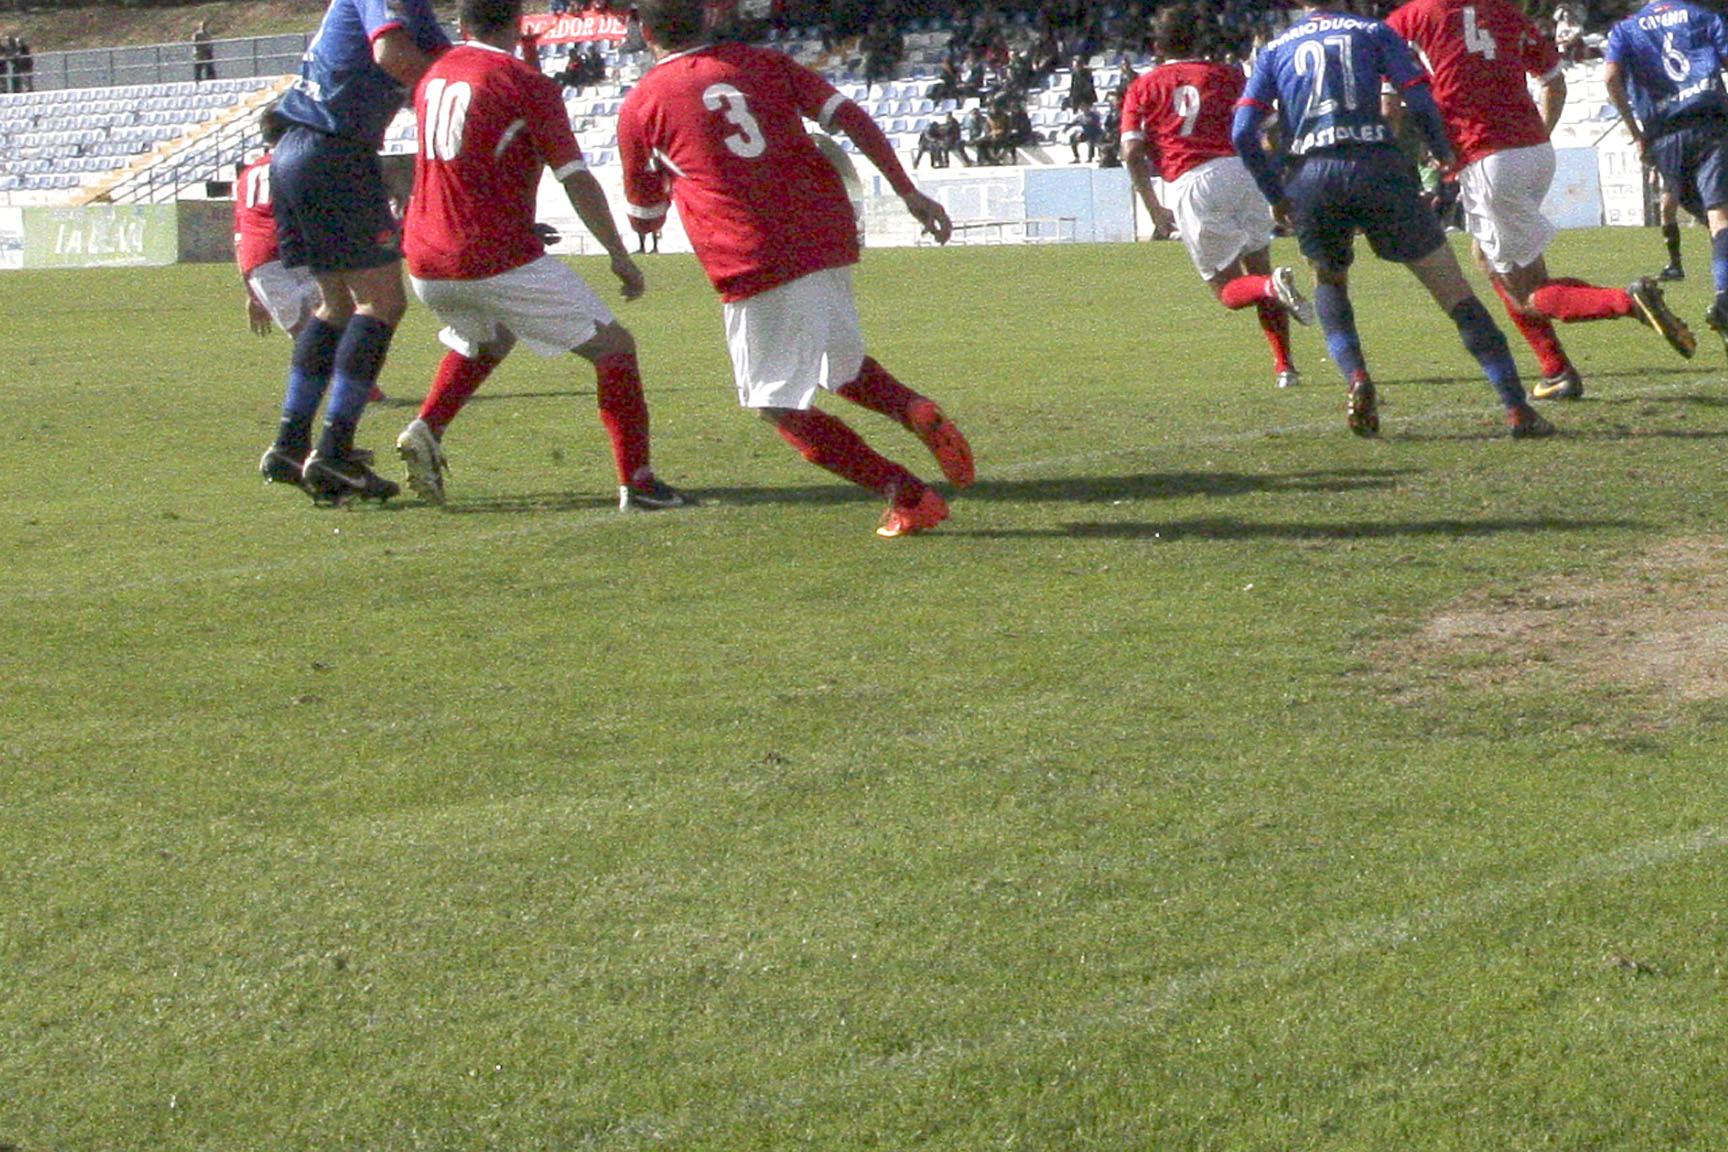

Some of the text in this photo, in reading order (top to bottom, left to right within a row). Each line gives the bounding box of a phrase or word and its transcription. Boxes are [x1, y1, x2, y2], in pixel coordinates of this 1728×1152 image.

[1462, 6, 1497, 60] 4
[1662, 31, 1691, 82] 6
[1293, 34, 1357, 119] 21
[424, 78, 472, 161] 10
[702, 82, 768, 158] 3
[1173, 84, 1201, 137] 9
